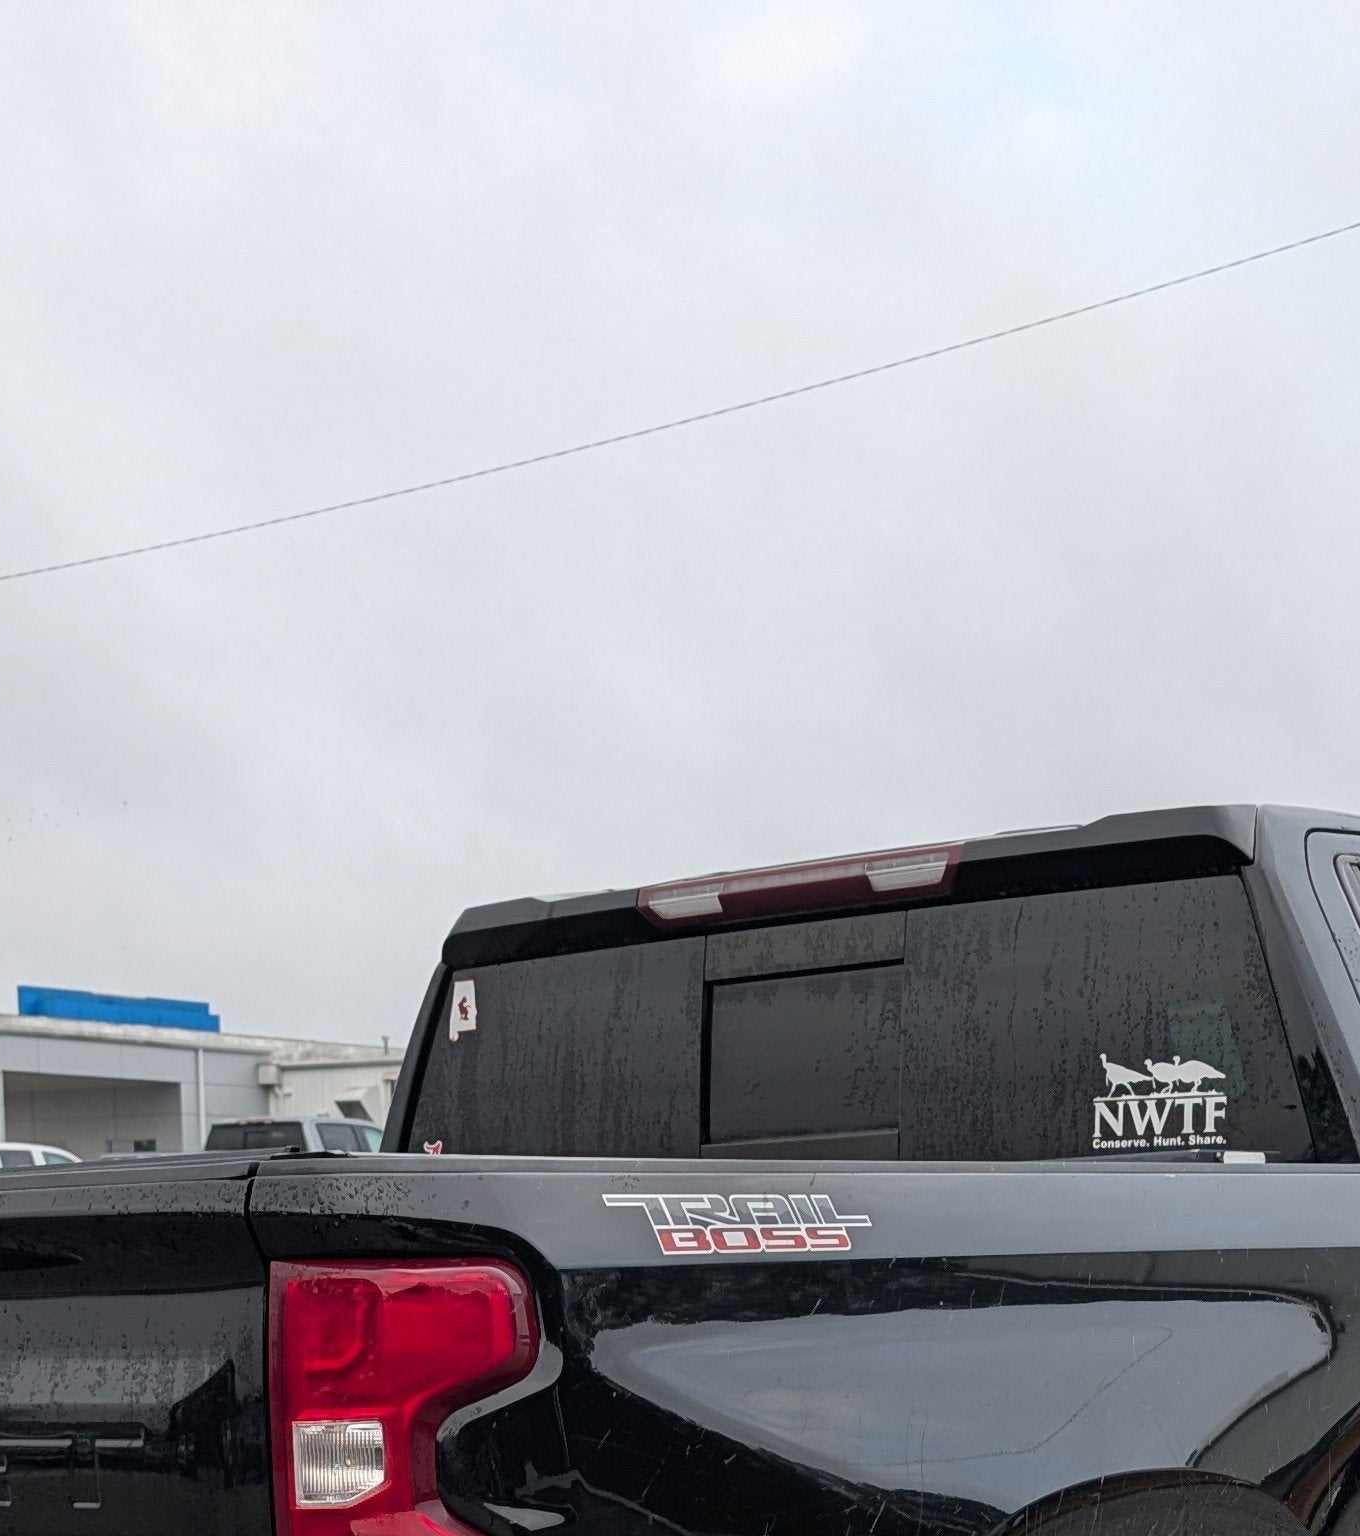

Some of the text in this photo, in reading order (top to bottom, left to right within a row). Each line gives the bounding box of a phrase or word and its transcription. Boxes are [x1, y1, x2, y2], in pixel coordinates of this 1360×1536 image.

[1092, 1096, 1228, 1138] NWTF
[1093, 1134, 1227, 1149] Conserve. Hunt. Share.
[602, 1193, 872, 1227] TRAIL
[655, 1225, 852, 1255] BOSS
